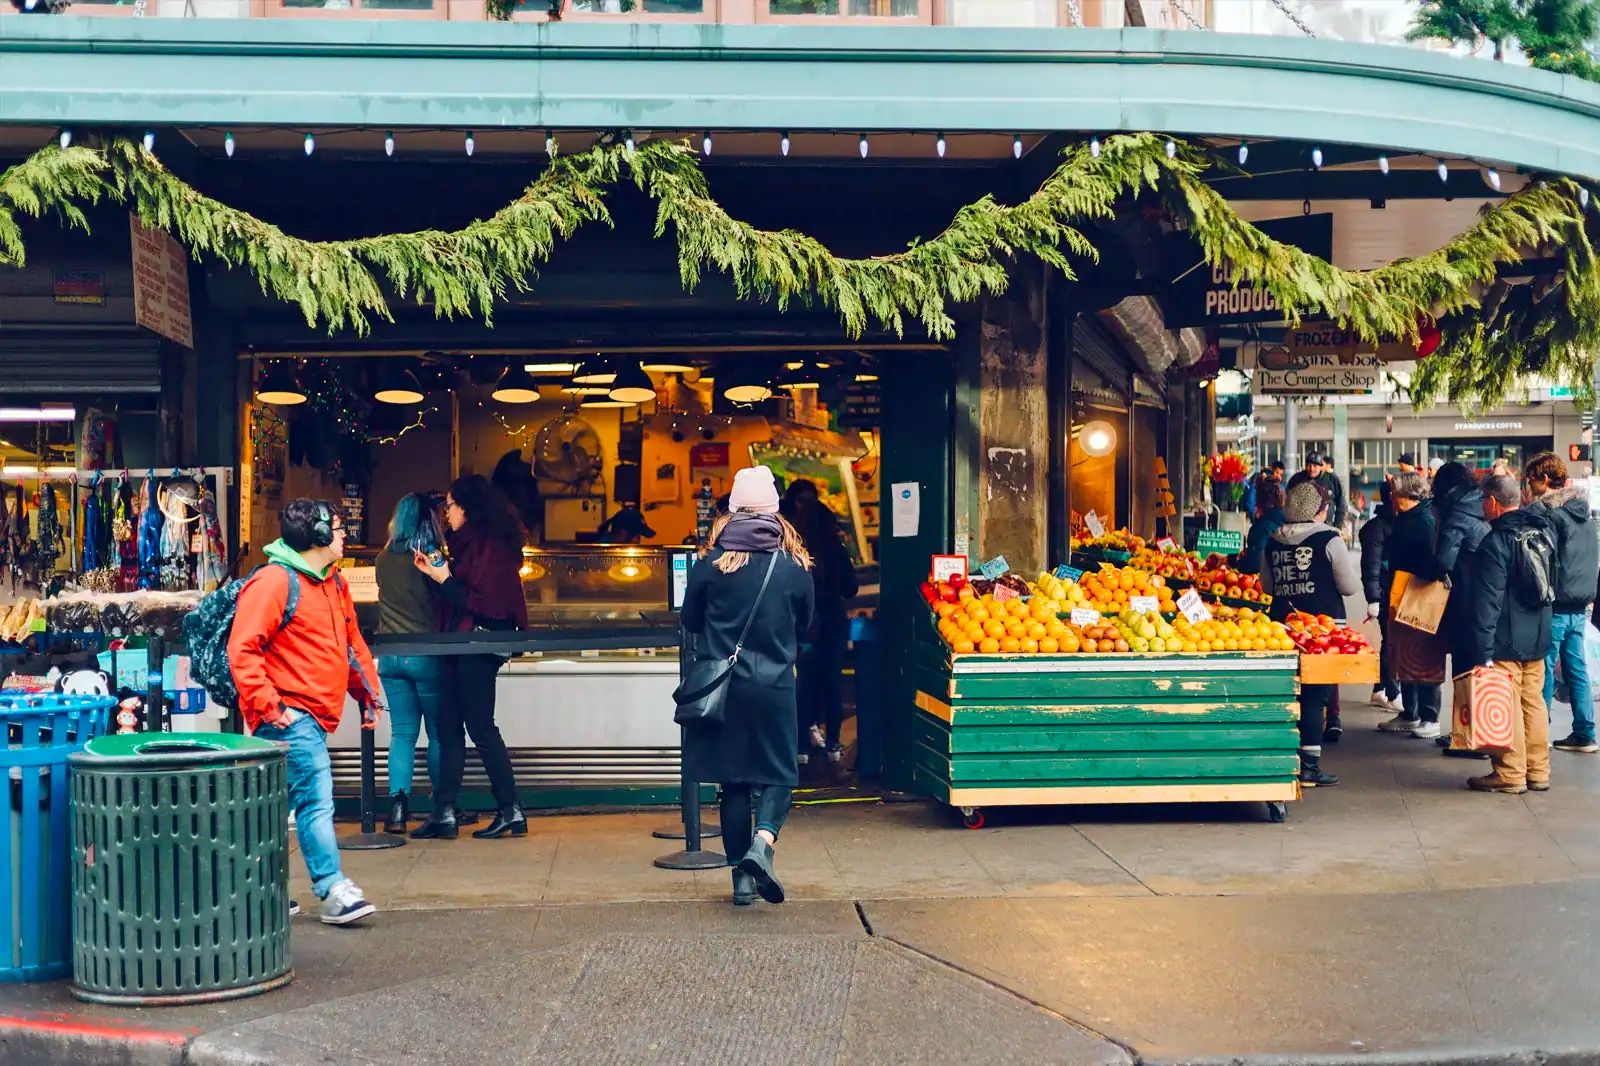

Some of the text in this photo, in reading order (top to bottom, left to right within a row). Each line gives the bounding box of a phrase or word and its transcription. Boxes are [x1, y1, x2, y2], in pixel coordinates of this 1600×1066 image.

[1257, 370, 1375, 389] The Crumpet Shop
[1455, 421, 1523, 431] STARBUCKS COFFEE
[1199, 530, 1240, 539] PIKE PLACE
[1273, 565, 1310, 583] DIE MY
